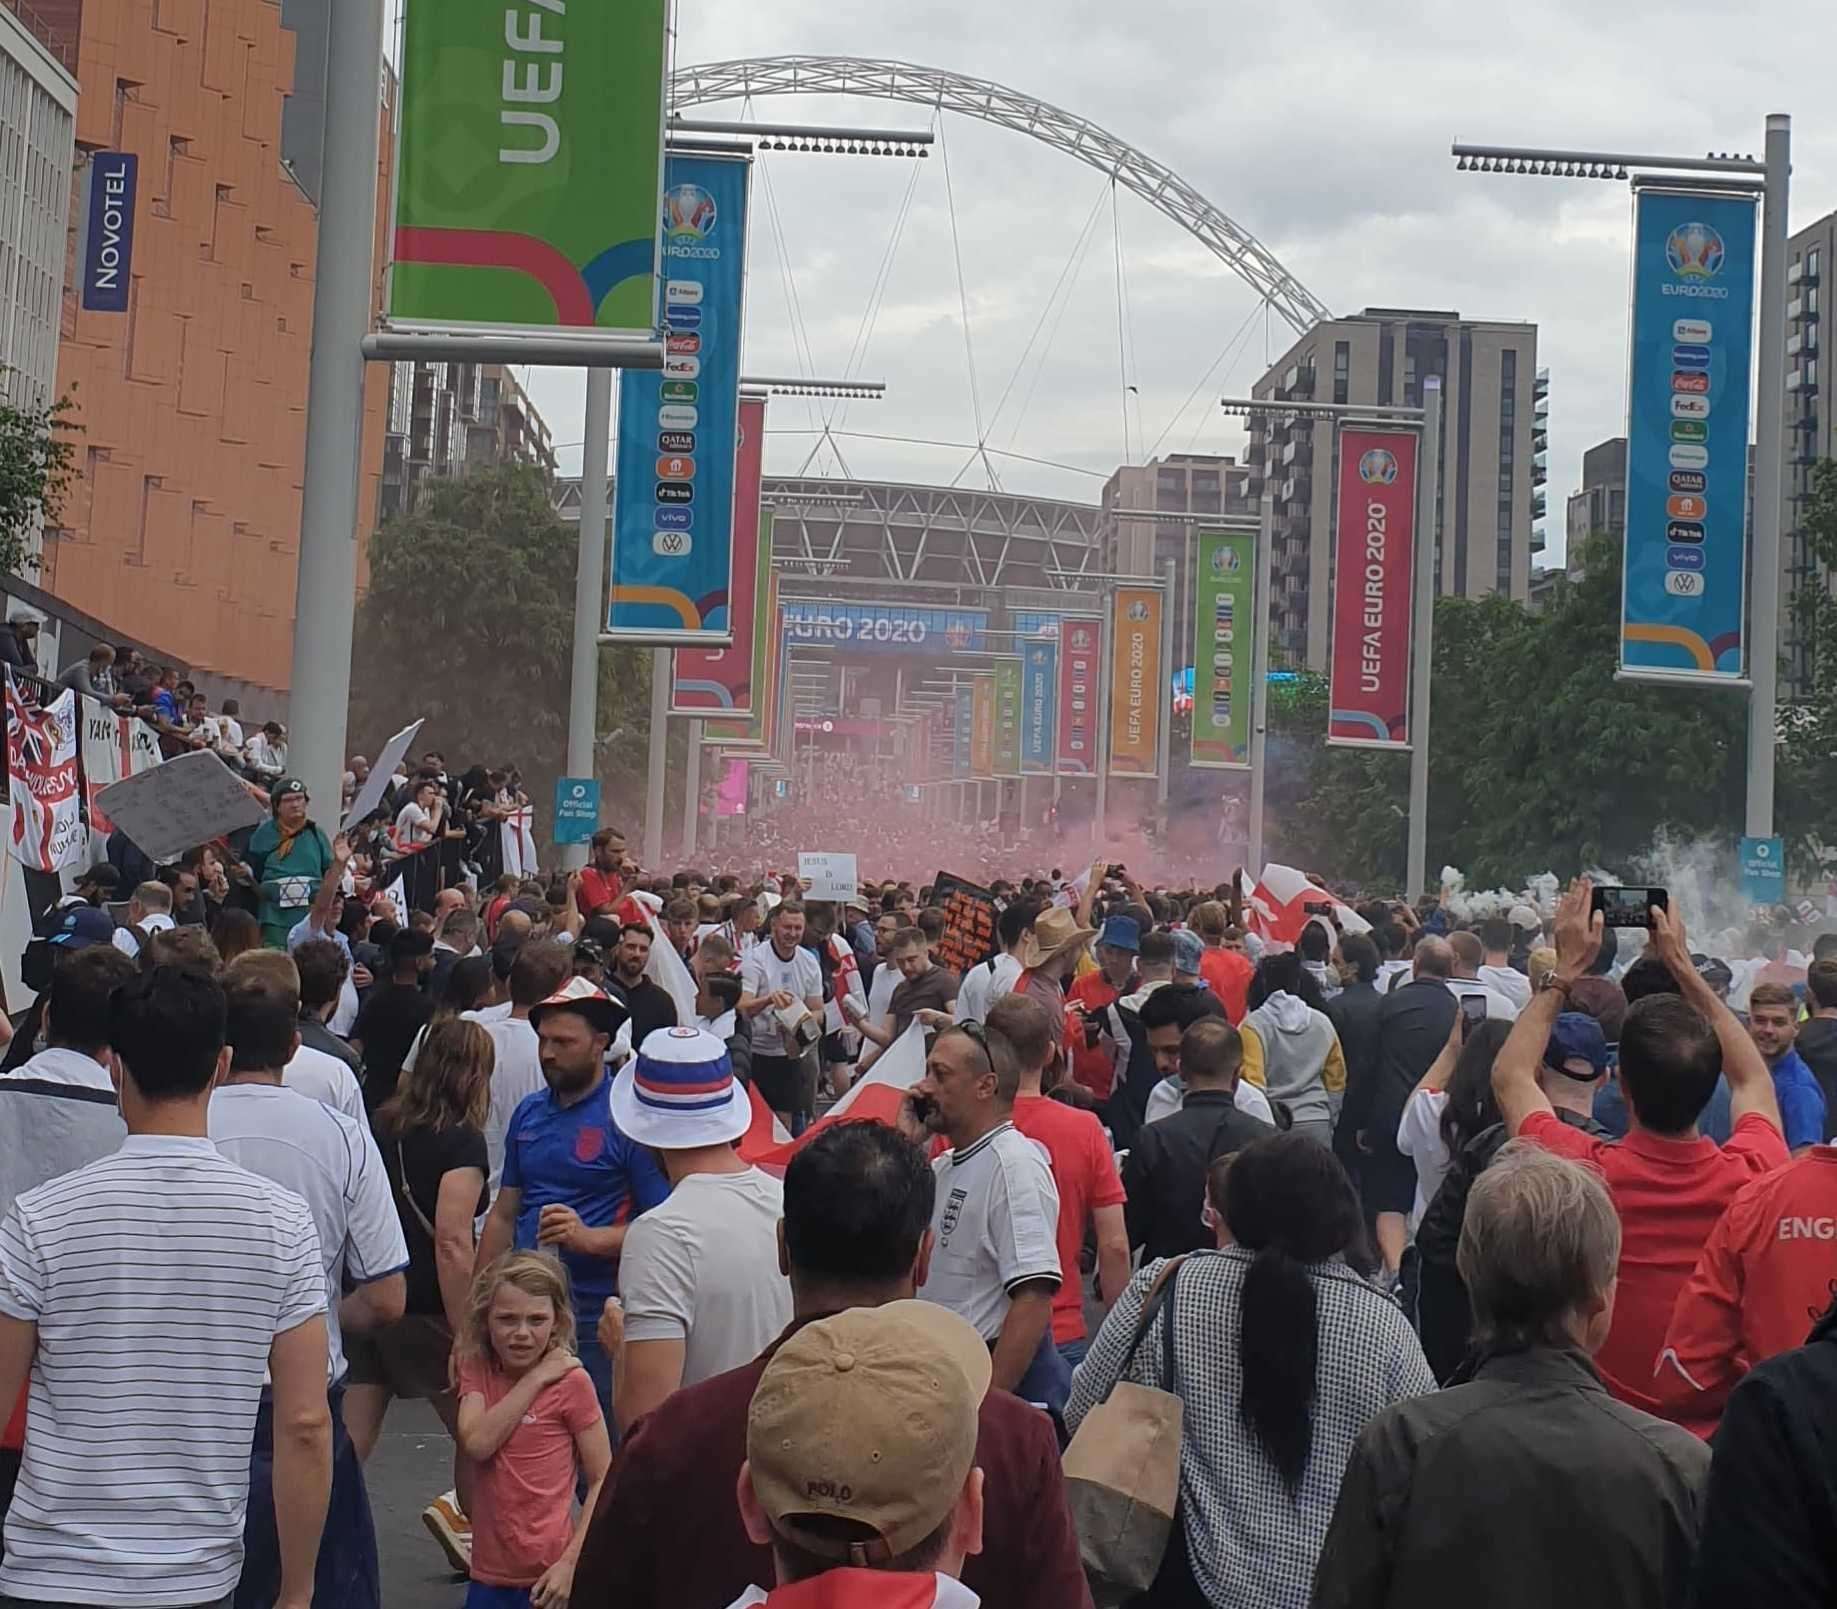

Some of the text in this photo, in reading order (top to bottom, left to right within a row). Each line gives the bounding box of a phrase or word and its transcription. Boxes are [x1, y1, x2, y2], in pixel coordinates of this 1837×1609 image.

[95, 162, 126, 289] NOVOTEL
[662, 246, 721, 260] URO2020
[662, 435, 693, 445] QATAR
[1672, 474, 1703, 485] QATAR
[661, 514, 687, 522] vivo
[1673, 553, 1698, 562] vivo
[1361, 502, 1387, 693] UEFA EURO 2020
[857, 617, 926, 643] 2020
[1128, 632, 1144, 745] UEFA EURO 2020
[806, 1480, 851, 1504] POLO
